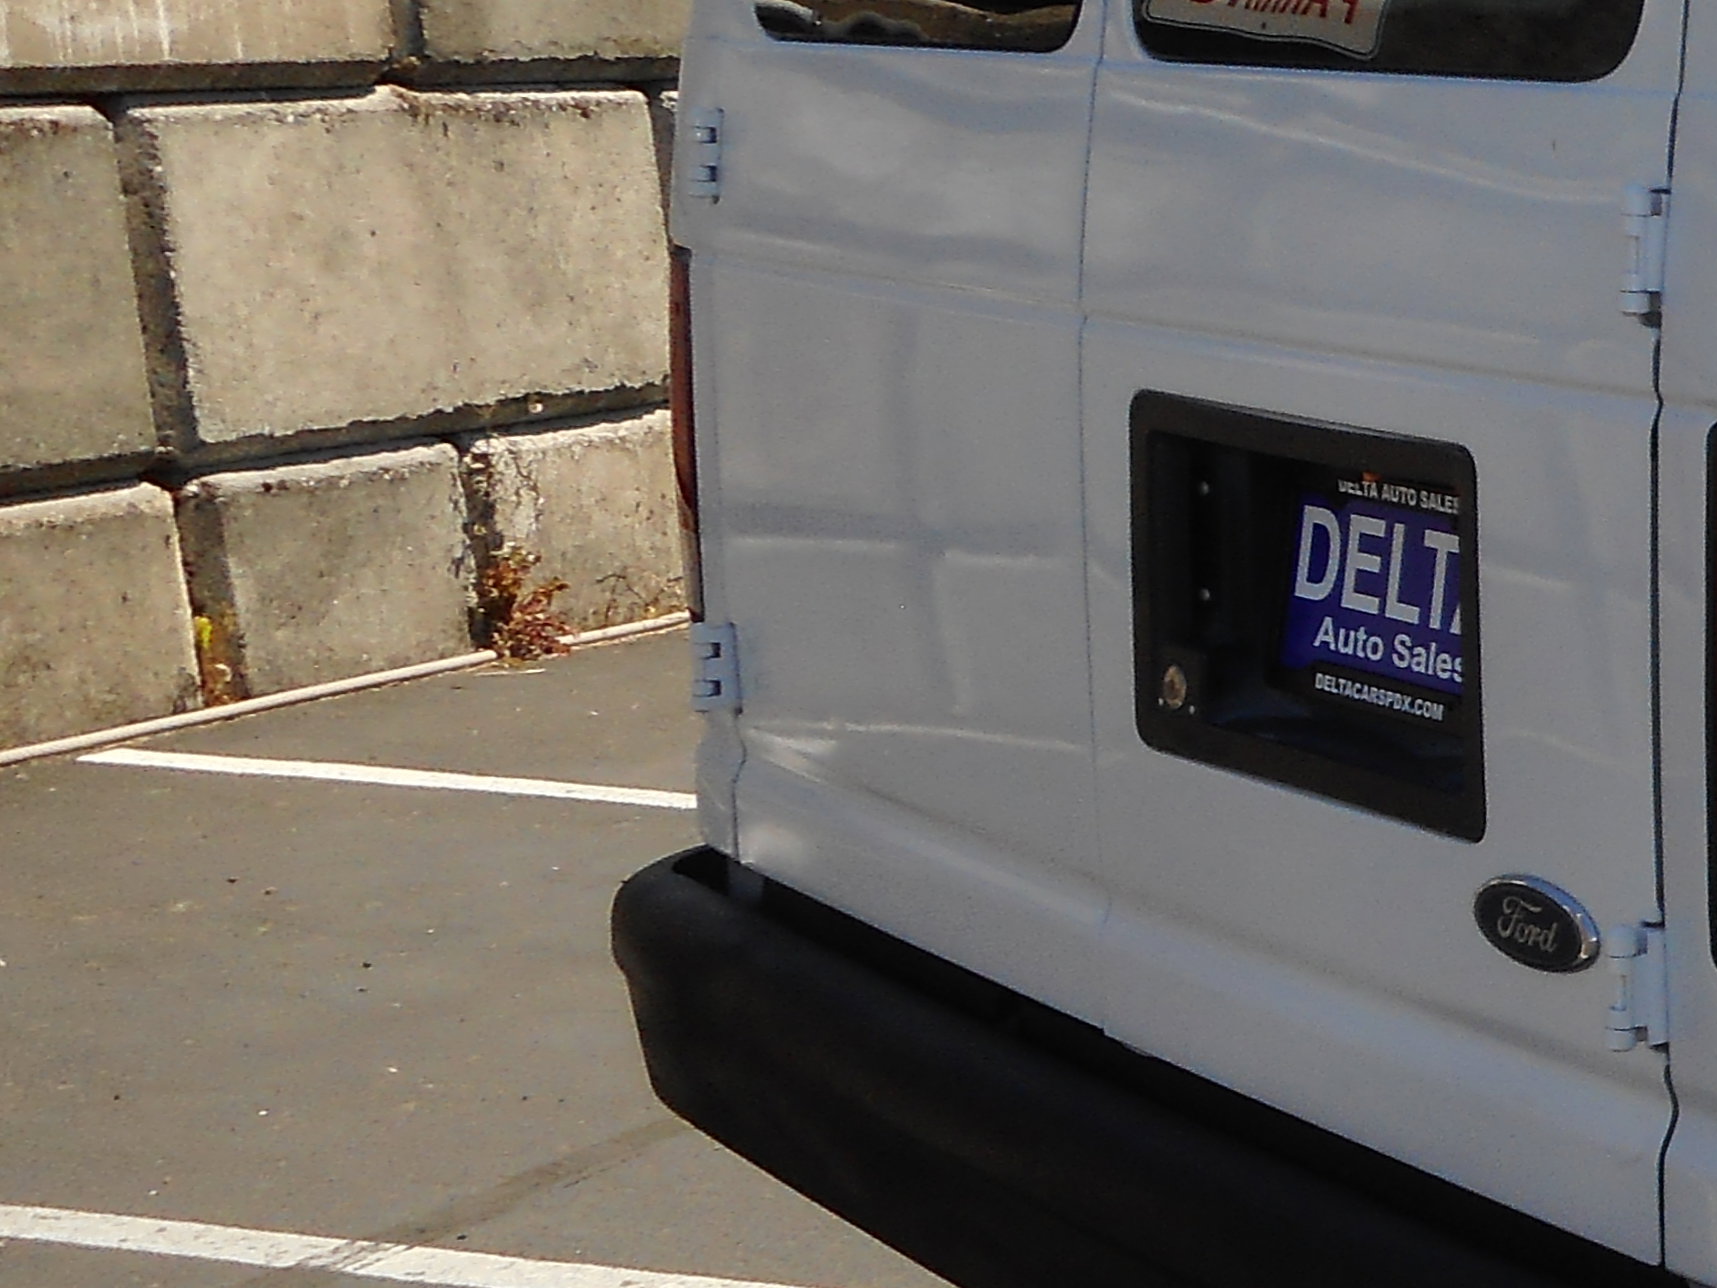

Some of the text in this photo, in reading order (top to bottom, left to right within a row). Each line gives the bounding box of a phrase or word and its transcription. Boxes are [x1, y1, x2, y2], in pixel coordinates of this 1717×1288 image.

[1337, 479, 1379, 499] DELTA
[1381, 483, 1417, 507] AUTO
[1312, 616, 1463, 683] Auto Sales
[1314, 672, 1445, 721] DELTACARSPDX.COM
[1497, 895, 1559, 953] Ford
